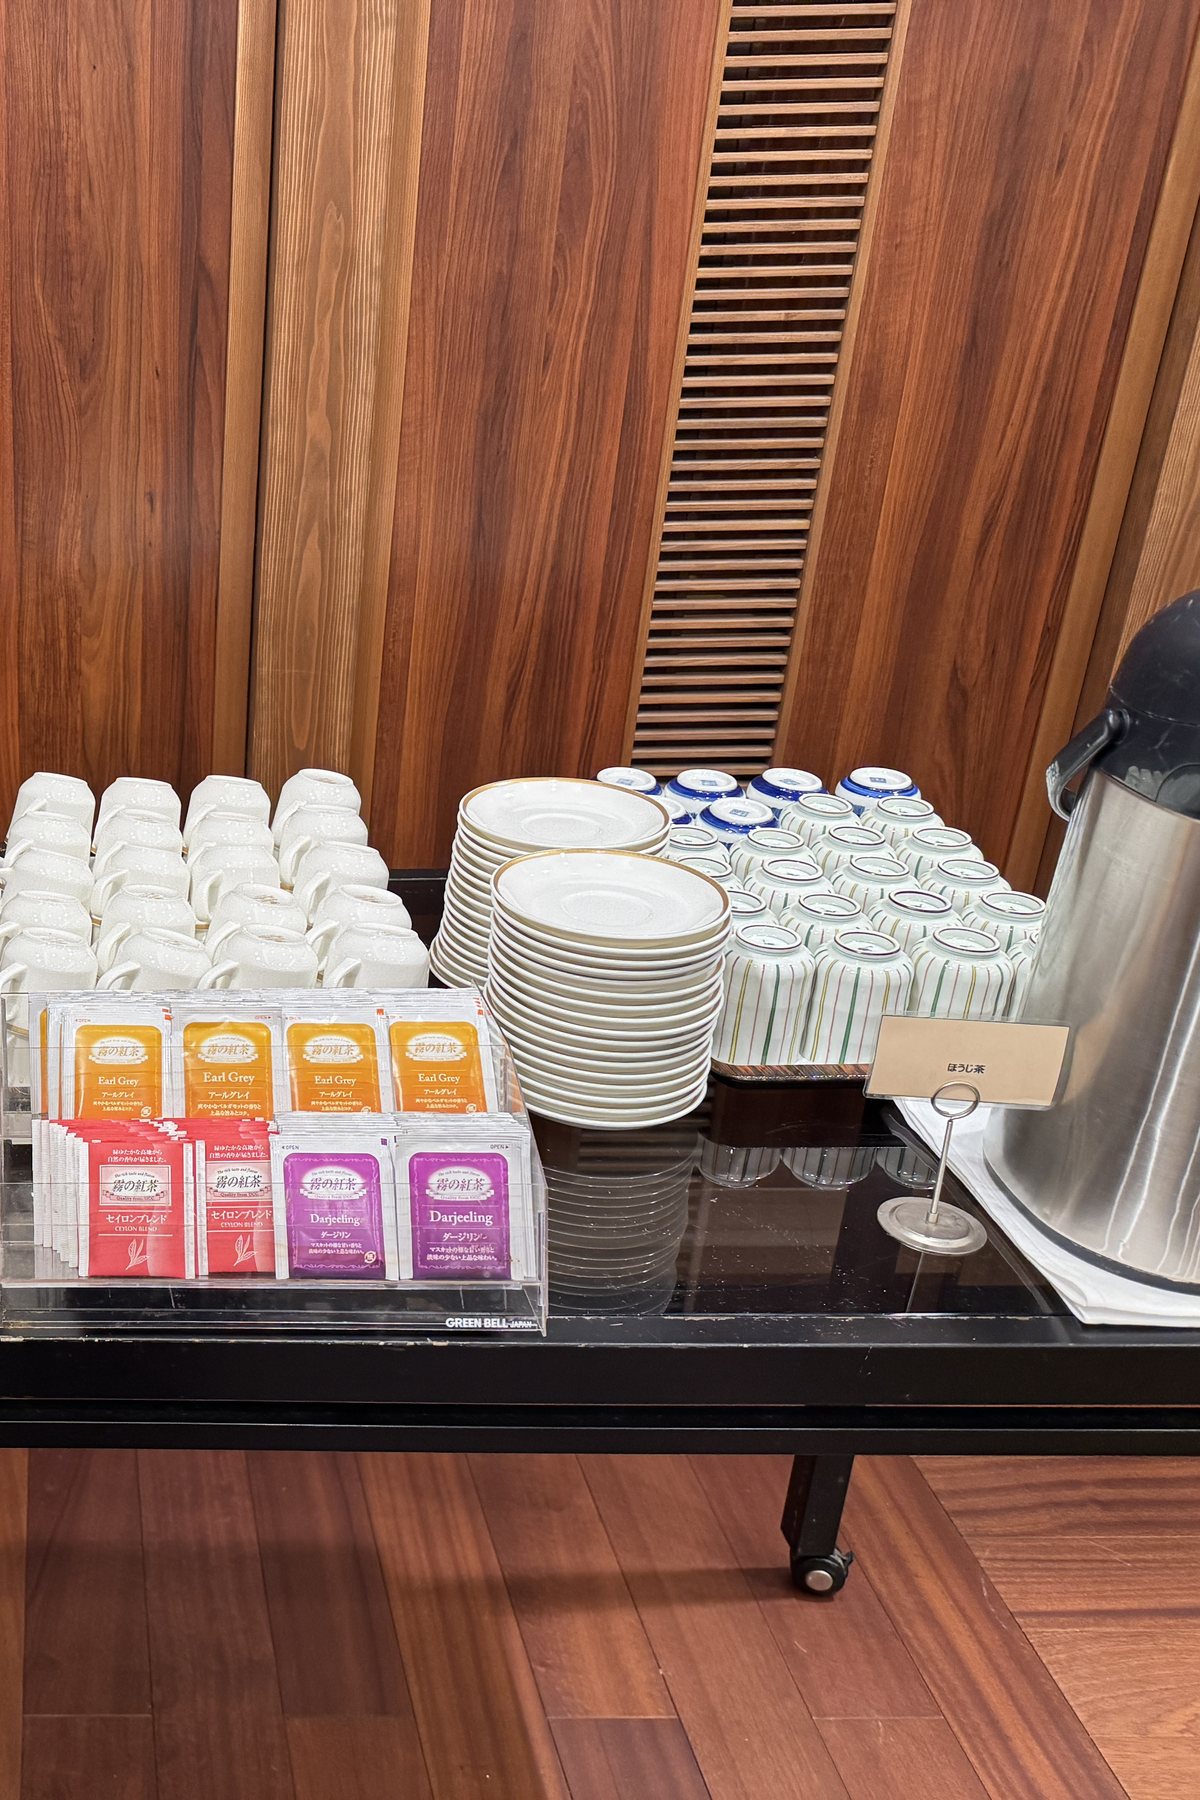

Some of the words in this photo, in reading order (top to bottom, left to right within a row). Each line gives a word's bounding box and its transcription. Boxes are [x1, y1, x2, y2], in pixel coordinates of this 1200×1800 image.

[947, 1063, 986, 1074] ほうじ茶
[98, 1077, 116, 1085] Earl
[117, 1076, 140, 1087] Grey
[203, 1072, 226, 1082] Earl
[228, 1072, 256, 1085] Grey
[314, 1075, 332, 1085] Earl
[334, 1075, 357, 1087] Grey
[418, 1073, 436, 1082] Earl
[438, 1073, 460, 1085] Grey
[208, 1091, 250, 1099] アールグレイ
[113, 1179, 159, 1192] 霧の紅茶
[216, 1175, 262, 1188] 霧の紅茶
[310, 1178, 357, 1191] 霧の紅茶
[437, 1178, 485, 1191] 霧の紅茶
[106, 1214, 167, 1224] セイロンブレンド
[211, 1210, 272, 1220] セイロンブレンド
[310, 1214, 360, 1226] Darjeeling
[430, 1210, 493, 1226] Darjeeling
[443, 1232, 482, 1241] ダージリン
[445, 1318, 481, 1328] GREEN
[483, 1318, 508, 1328] BELL
[511, 1320, 532, 1328] JAPAN
